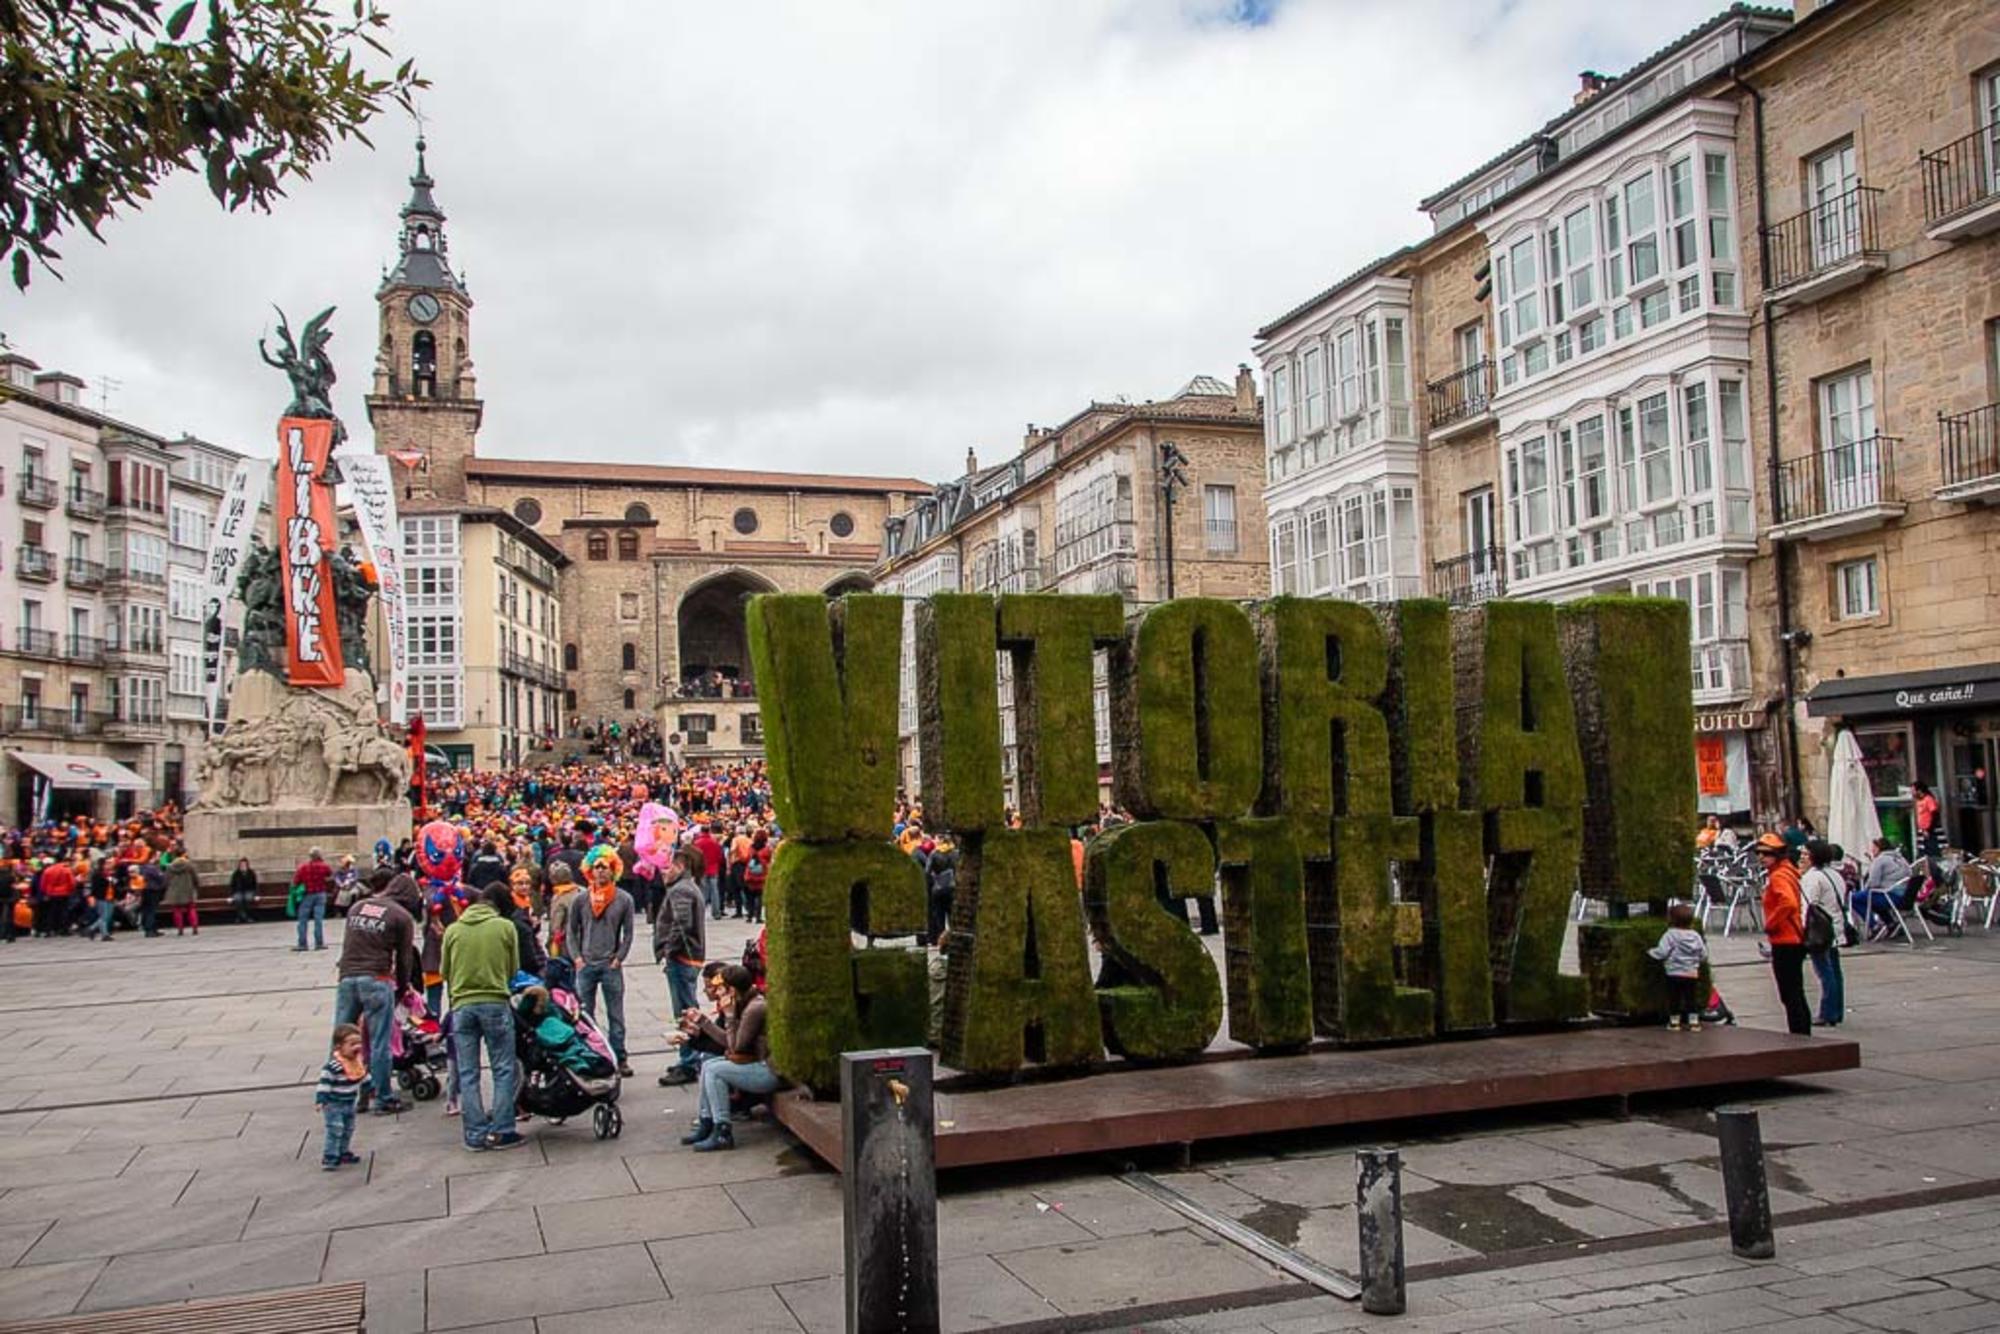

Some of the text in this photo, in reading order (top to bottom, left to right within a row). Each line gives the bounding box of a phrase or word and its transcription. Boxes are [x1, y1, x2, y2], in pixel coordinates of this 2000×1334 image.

[287, 427, 322, 662] LIBRE
[746, 592, 1582, 845] VITORIA
[1895, 690, 1927, 708] Que
[763, 805, 1590, 1095] GASTEIZ
